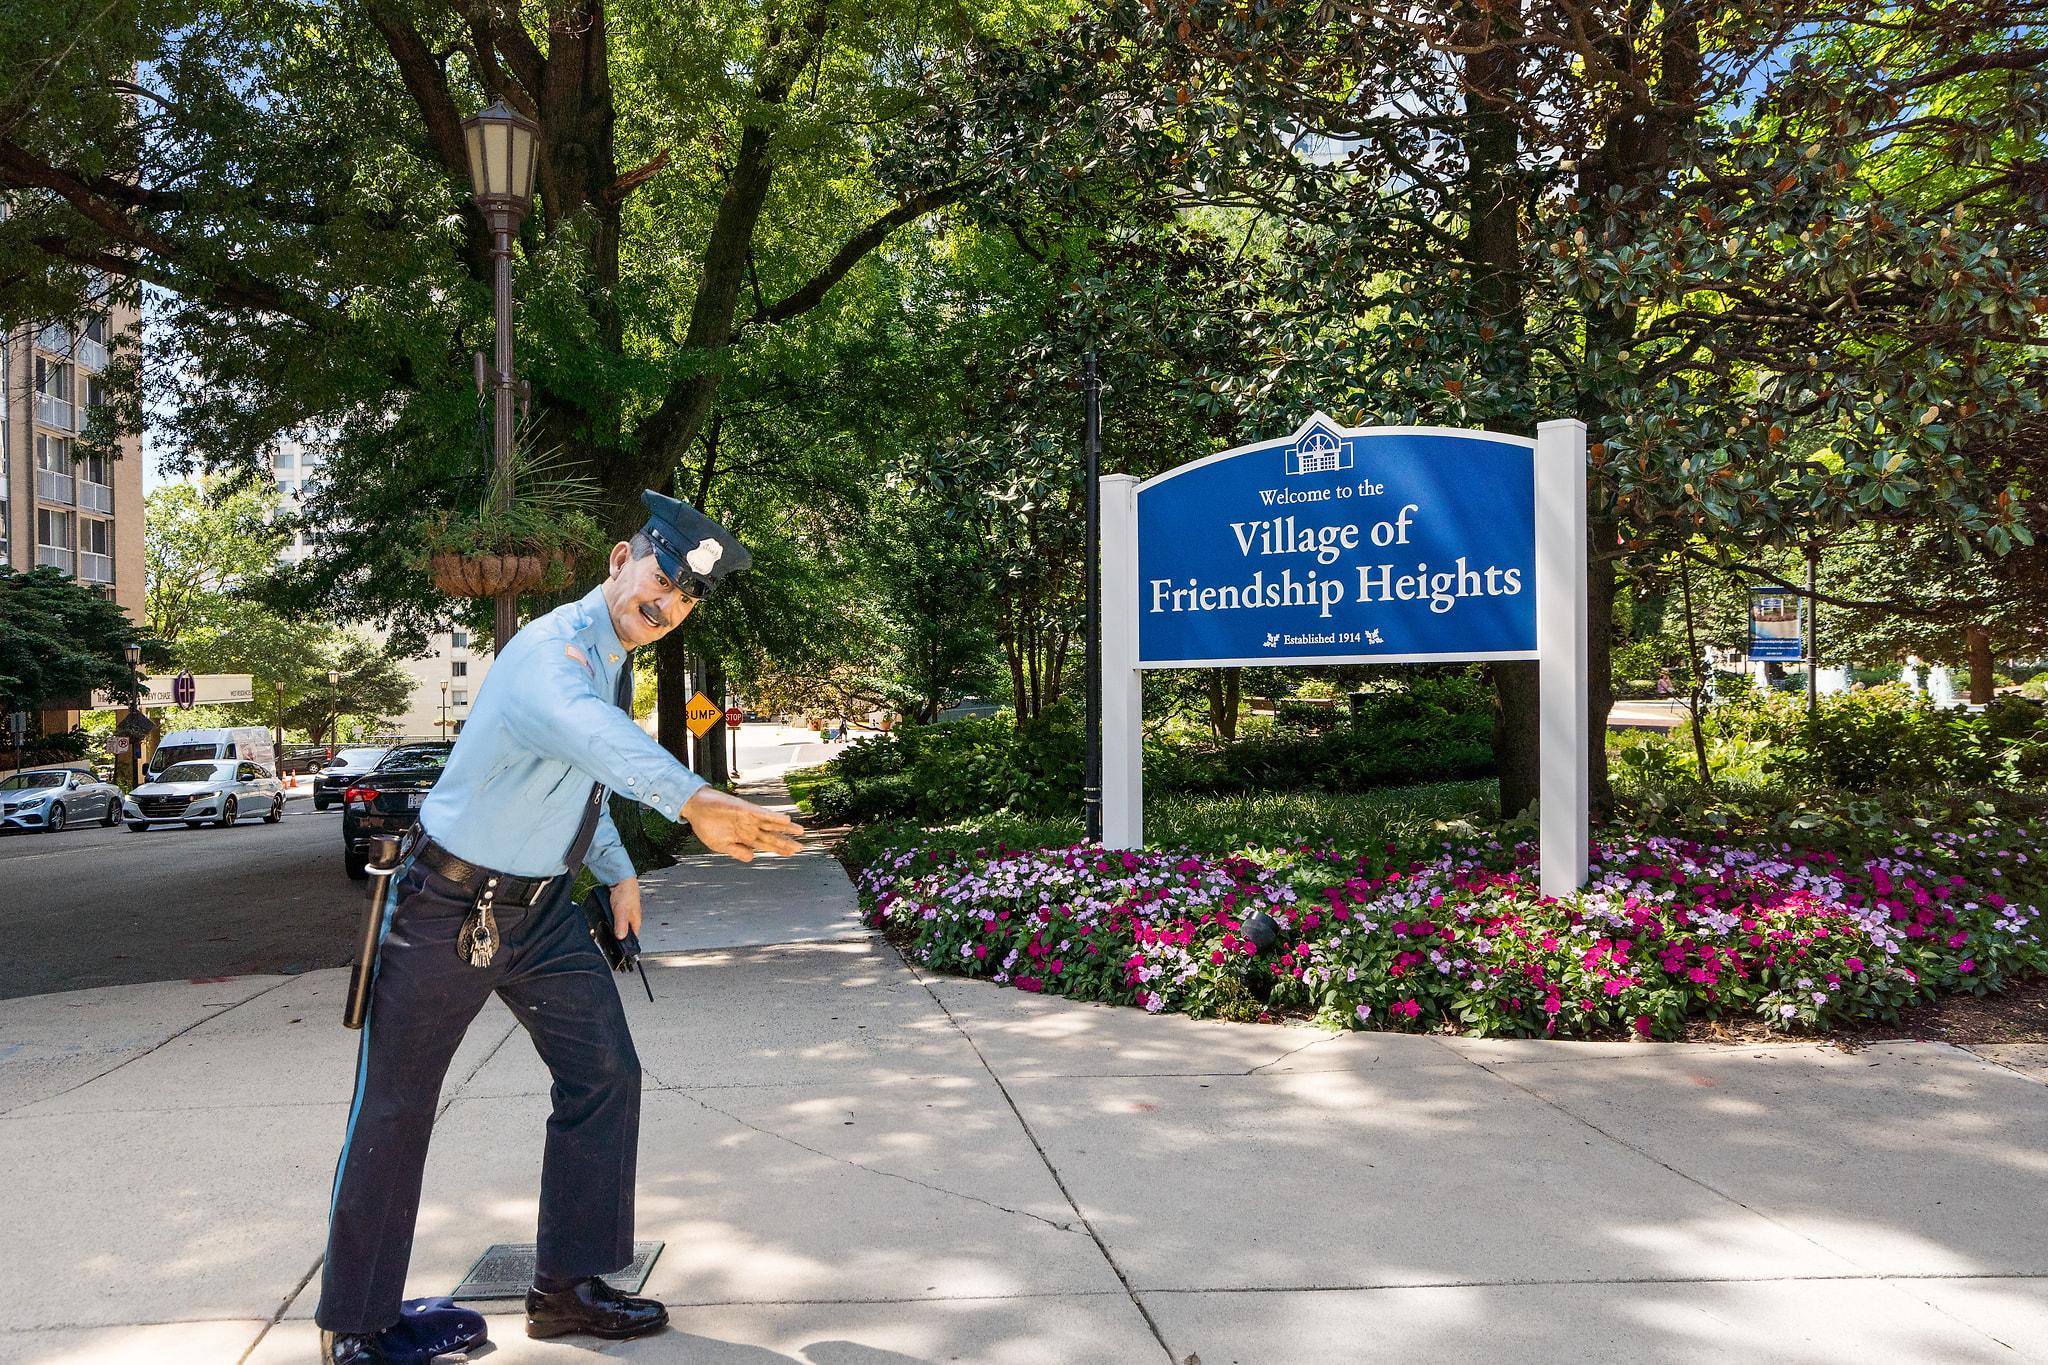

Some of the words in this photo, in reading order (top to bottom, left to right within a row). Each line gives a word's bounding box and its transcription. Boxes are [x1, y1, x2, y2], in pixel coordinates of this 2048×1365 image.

[1259, 488, 1331, 506] Welcome
[1336, 486, 1352, 499] to
[1358, 479, 1384, 496] the
[1230, 515, 1359, 564] Village
[1370, 503, 1418, 546] of
[1149, 569, 1344, 617] Friendship
[1356, 557, 1521, 613] Heights
[1283, 632, 1335, 645] Established
[1338, 632, 1361, 644] 1914
[685, 709, 716, 721] BUMP
[725, 713, 742, 722] STOP
